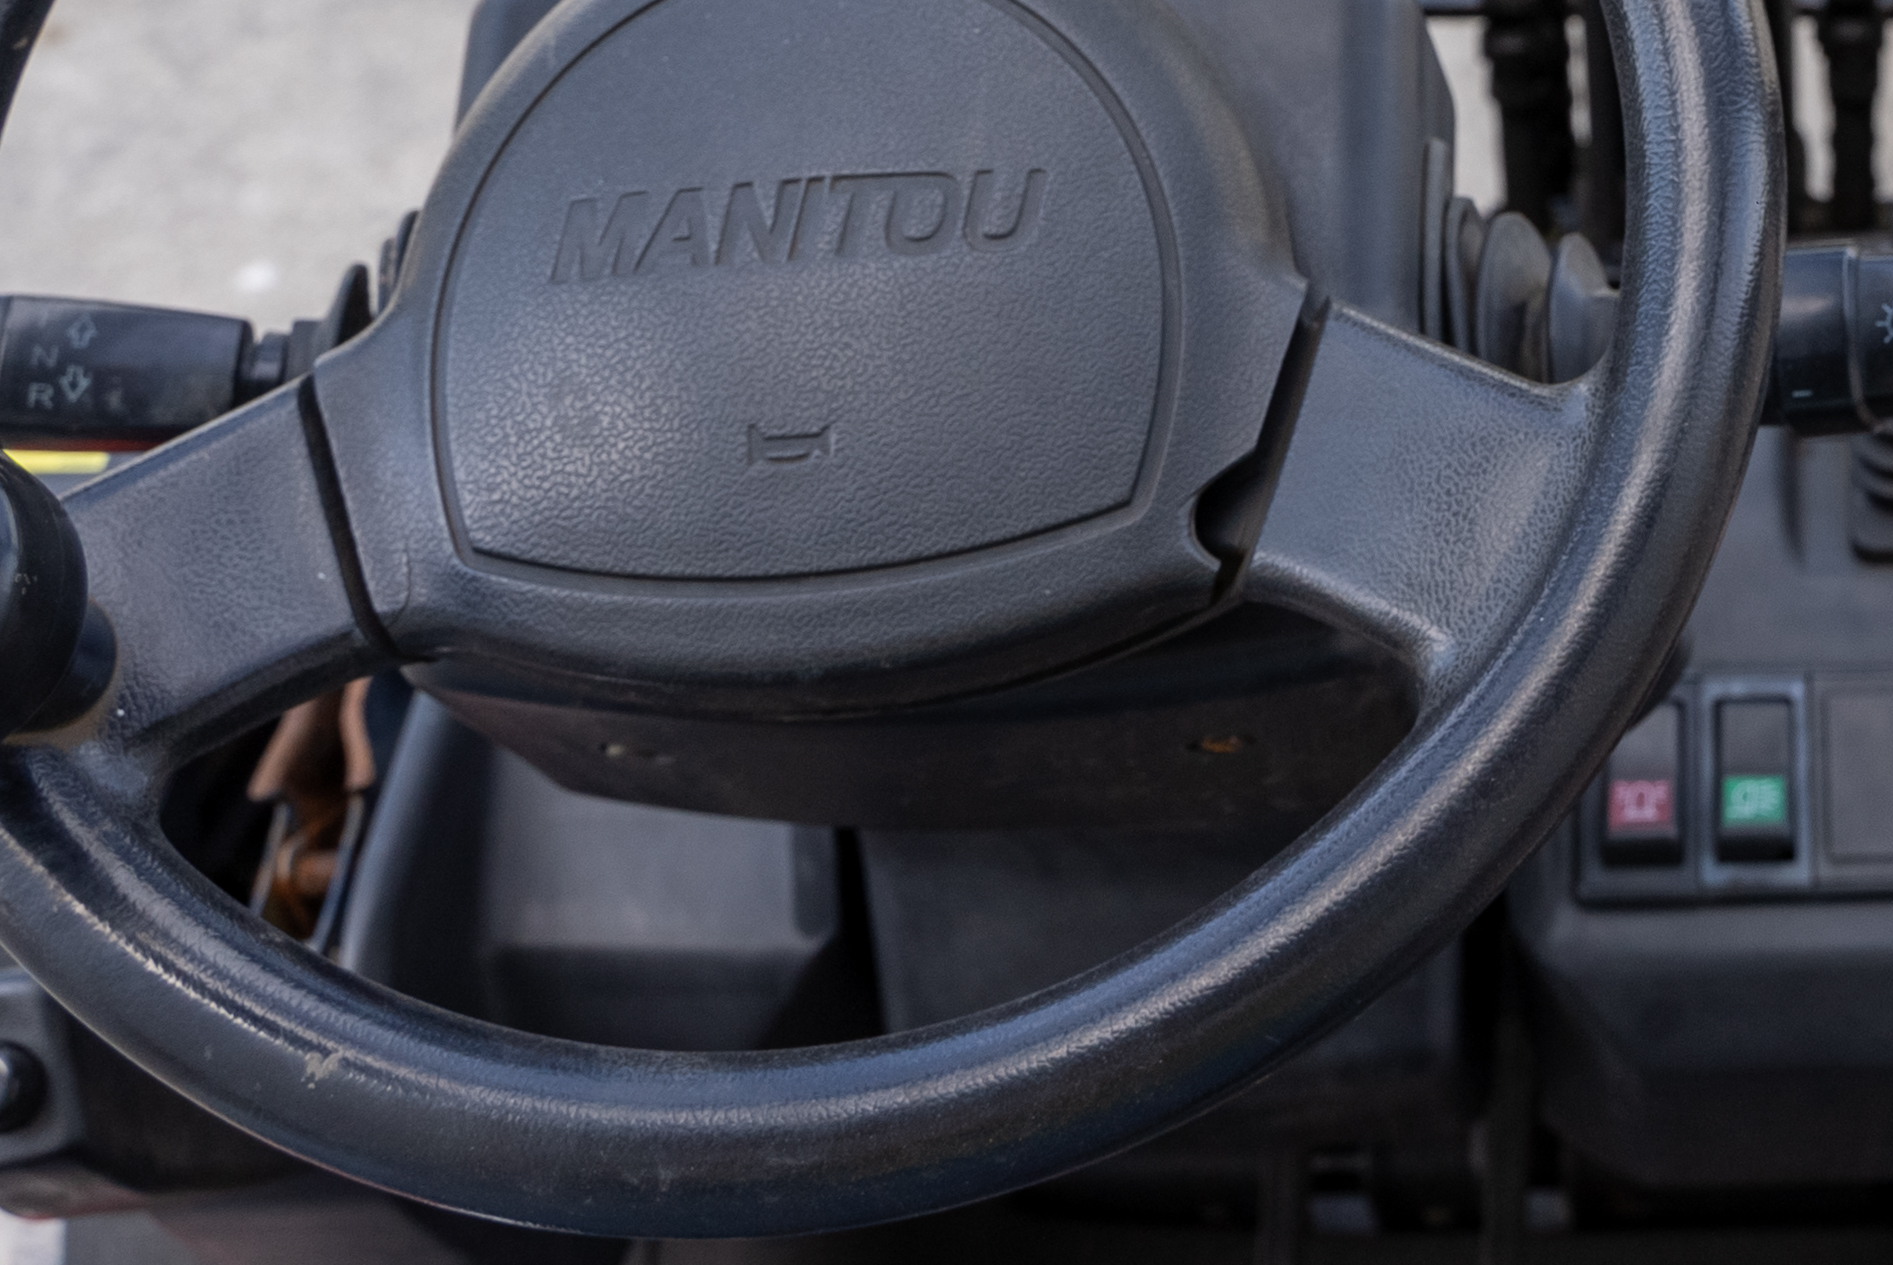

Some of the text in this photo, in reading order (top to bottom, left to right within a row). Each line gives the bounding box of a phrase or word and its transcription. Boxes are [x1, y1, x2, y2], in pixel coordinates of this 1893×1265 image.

[549, 167, 1048, 284] MANITOU
[29, 343, 60, 369] N
[26, 381, 55, 409] R
